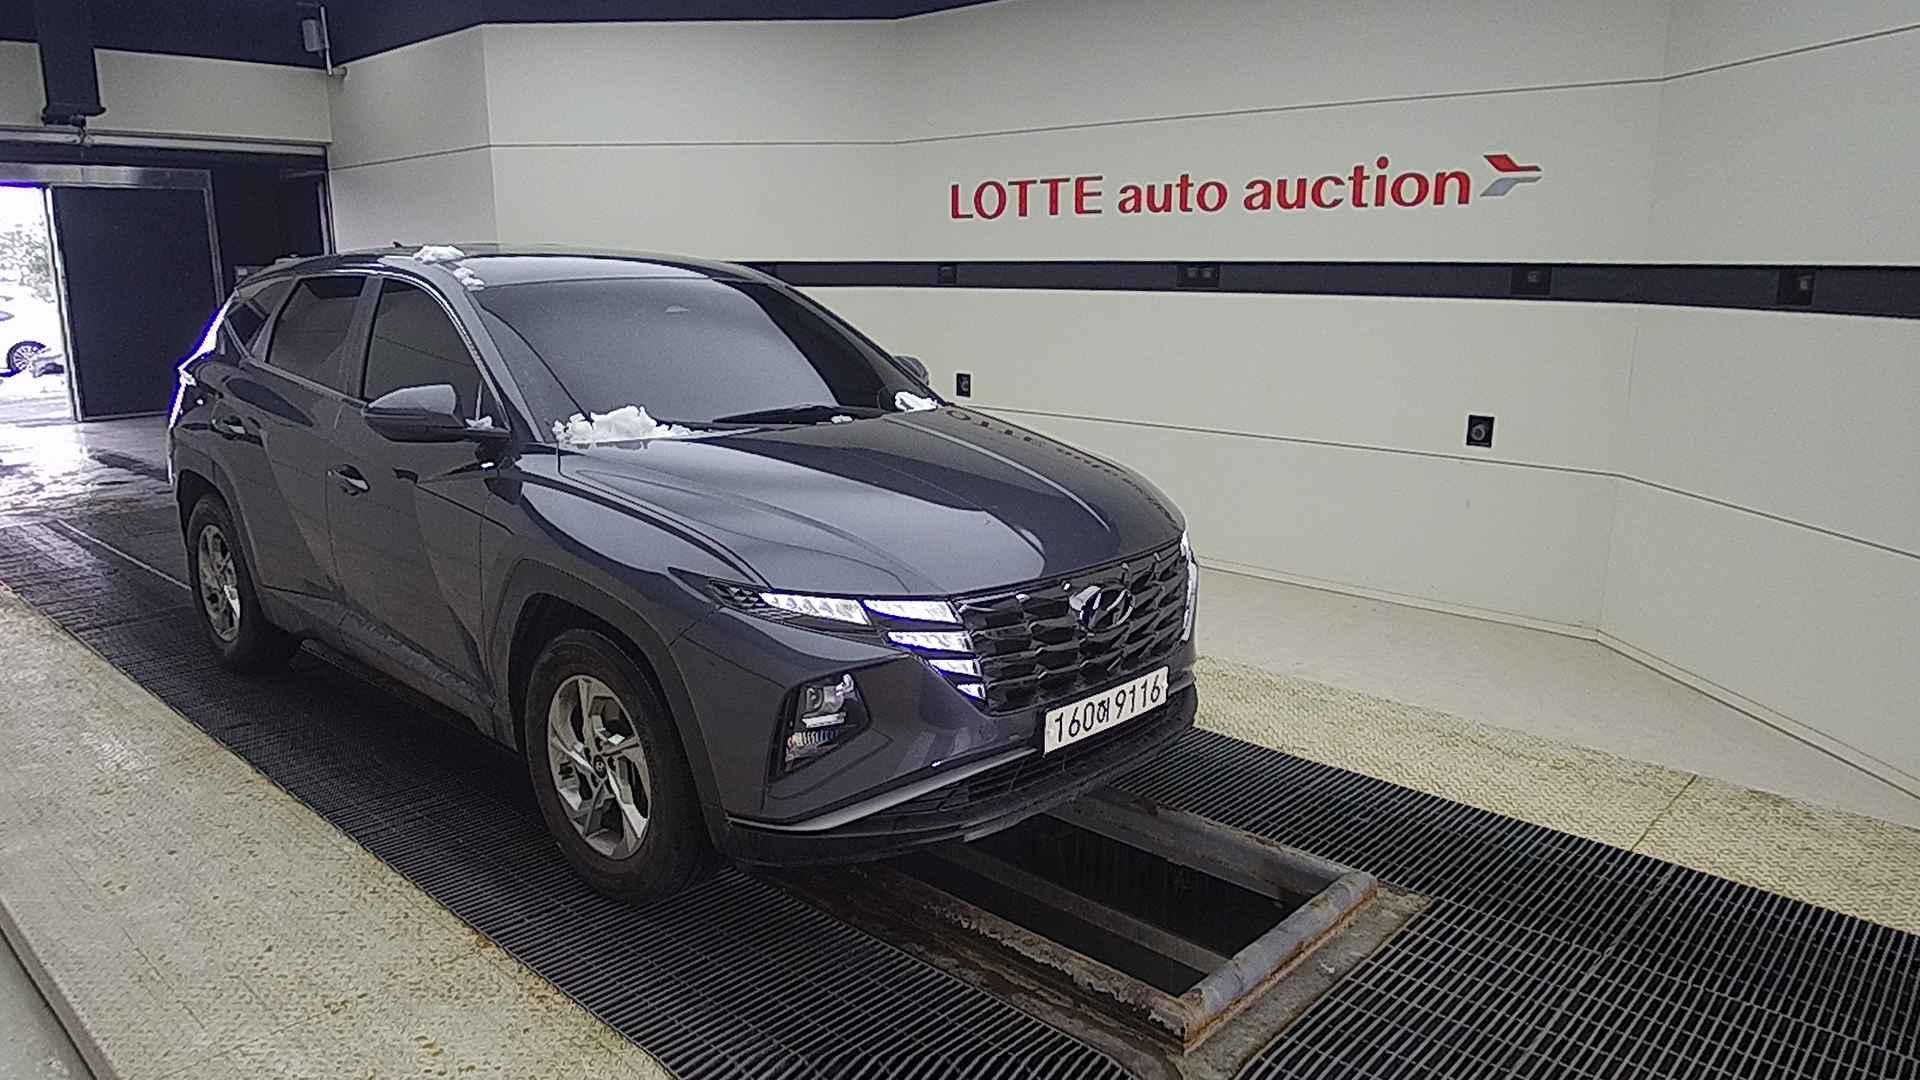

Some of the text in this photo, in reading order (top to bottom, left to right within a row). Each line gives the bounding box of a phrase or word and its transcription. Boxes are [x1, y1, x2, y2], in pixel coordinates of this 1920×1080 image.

[951, 156, 1472, 219] LOTTE auto auction
